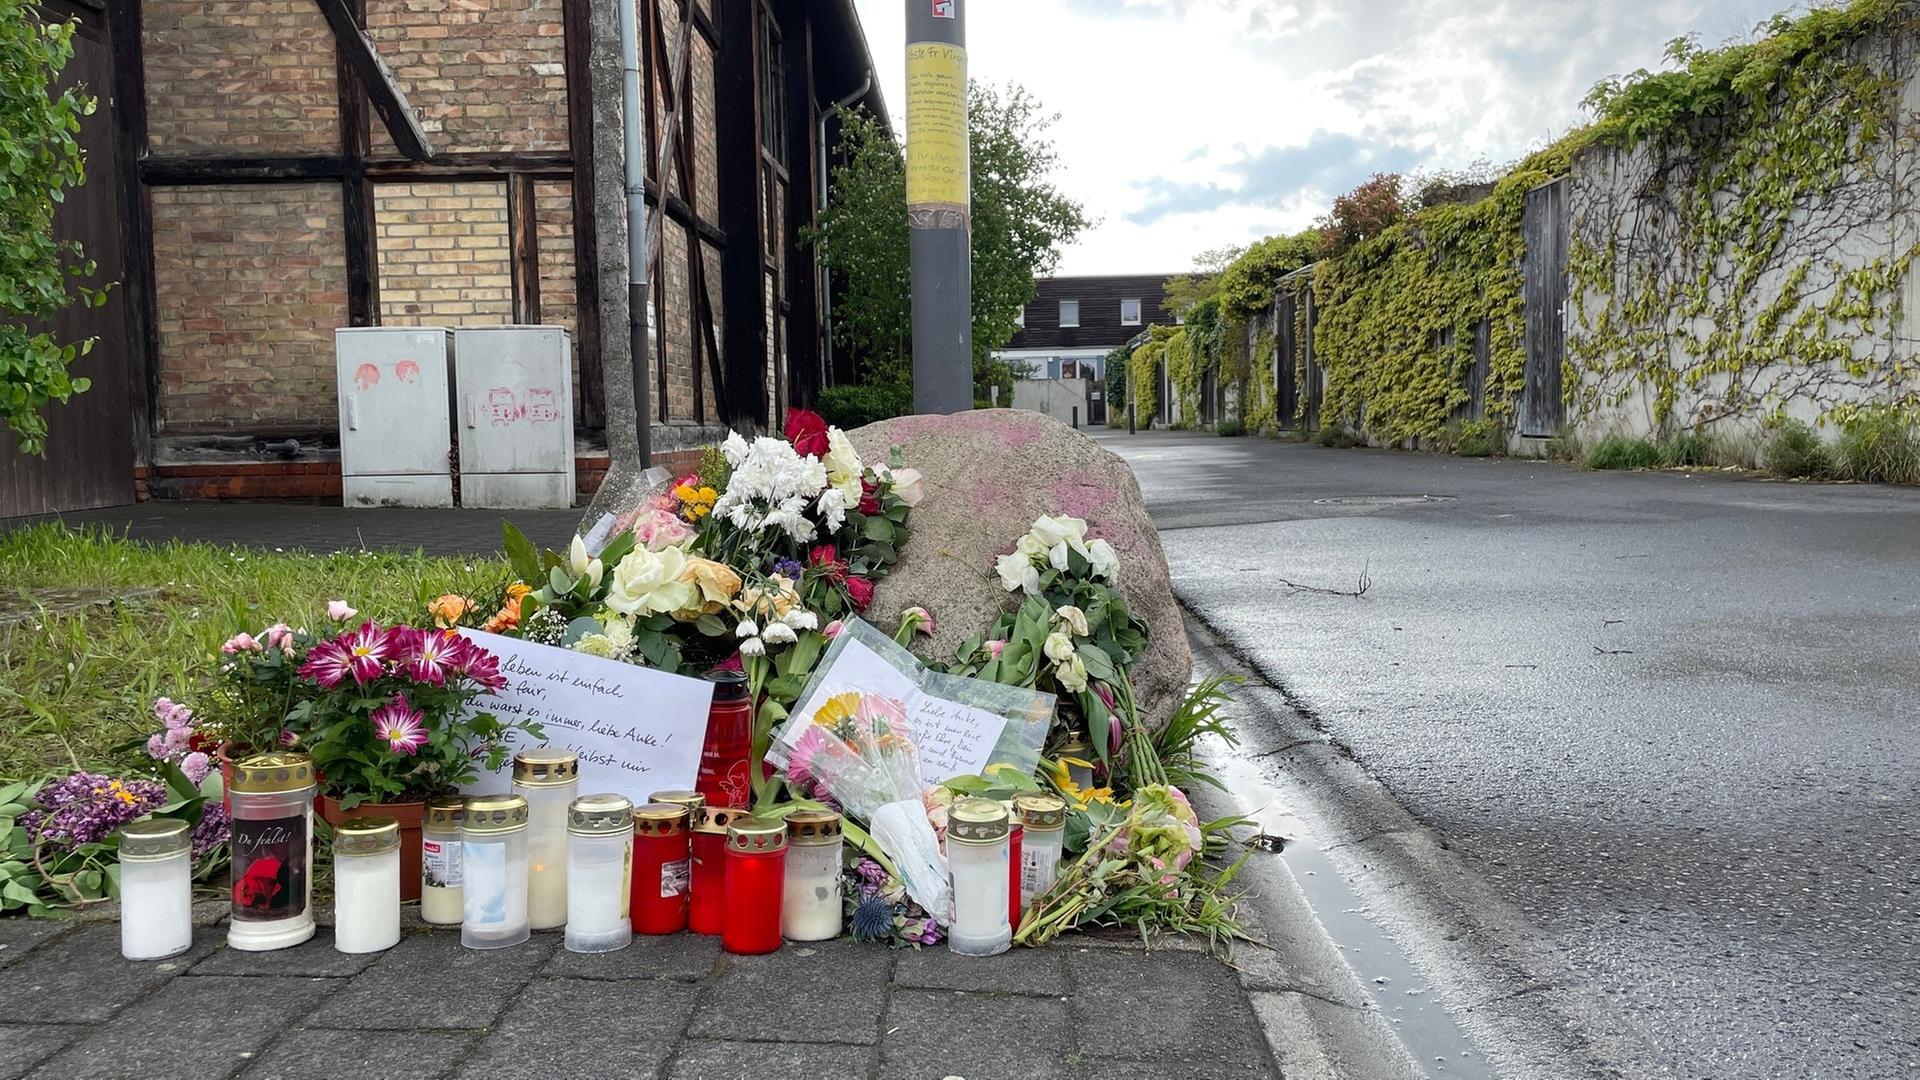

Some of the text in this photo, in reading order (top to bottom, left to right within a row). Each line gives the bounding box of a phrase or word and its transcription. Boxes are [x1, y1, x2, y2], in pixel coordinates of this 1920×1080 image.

[501, 654, 624, 698] Leben ist einfach
[516, 681, 546, 701] fair,
[489, 702, 522, 715] warst
[527, 707, 540, 717] es
[546, 709, 585, 730] immer,
[588, 719, 622, 738] liebe
[621, 760, 650, 773] mir
[238, 826, 292, 857] Du fehlst!
